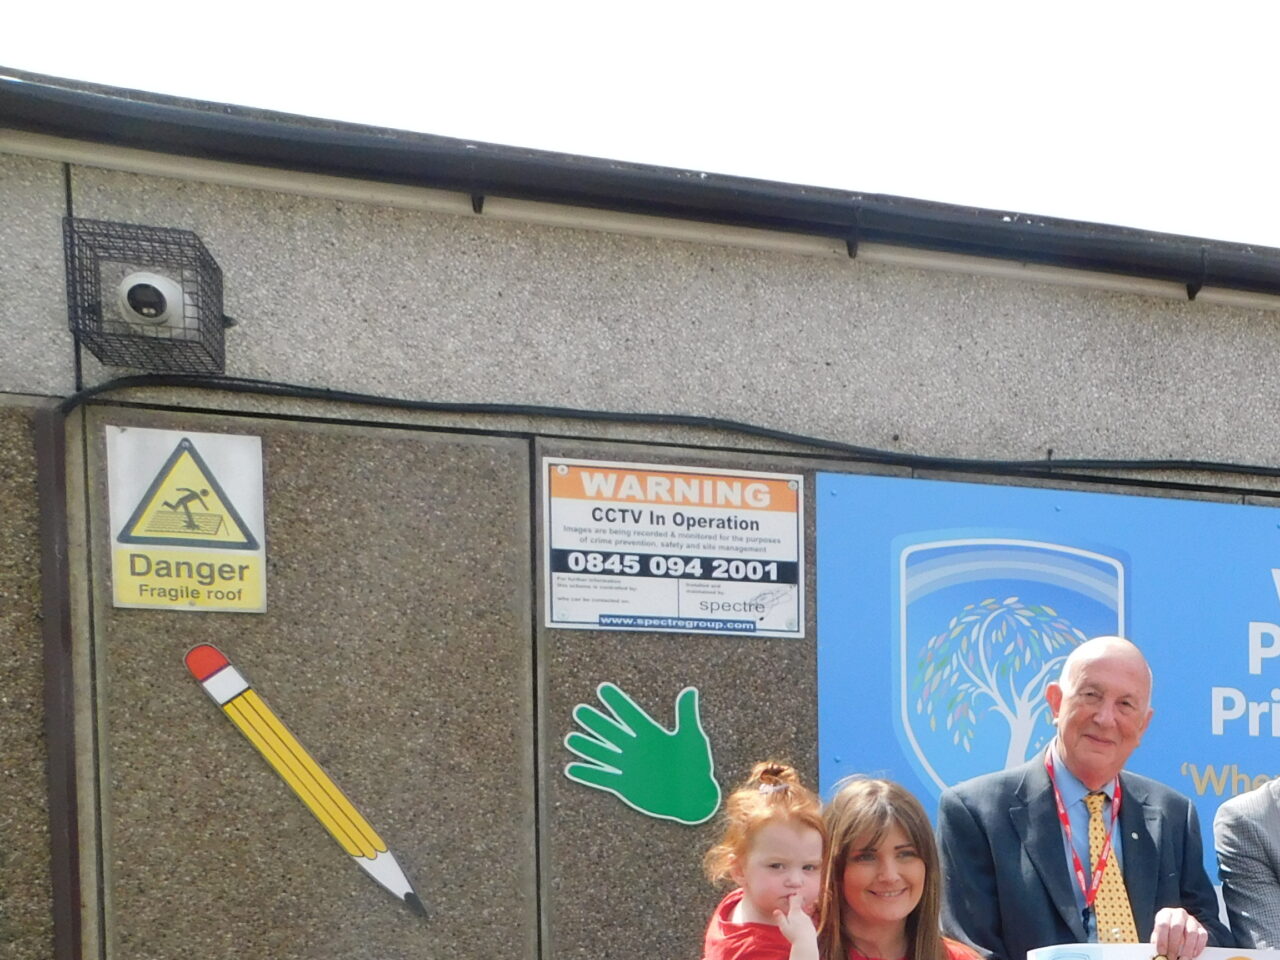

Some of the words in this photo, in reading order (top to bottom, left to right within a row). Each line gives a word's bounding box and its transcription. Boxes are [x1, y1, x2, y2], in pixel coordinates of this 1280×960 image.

[580, 471, 771, 508] WARNING
[591, 507, 643, 524] CCTV
[649, 510, 666, 526] In
[672, 512, 760, 531] Operation
[563, 525, 592, 535] Images
[609, 527, 631, 538] being
[633, 528, 668, 538] recorded
[678, 532, 717, 541] monitored
[746, 537, 781, 545] purposes
[590, 536, 613, 545] crime
[660, 540, 683, 550] safety
[686, 542, 700, 550] and
[718, 544, 767, 554] management
[129, 553, 250, 586] Danger
[567, 552, 641, 574] 0845
[649, 556, 703, 576] 094
[711, 559, 778, 581] 2001
[138, 583, 201, 602] Fragile
[206, 587, 243, 602] roof
[699, 600, 766, 614] spectre
[600, 616, 755, 630] www.spectregroup.com
